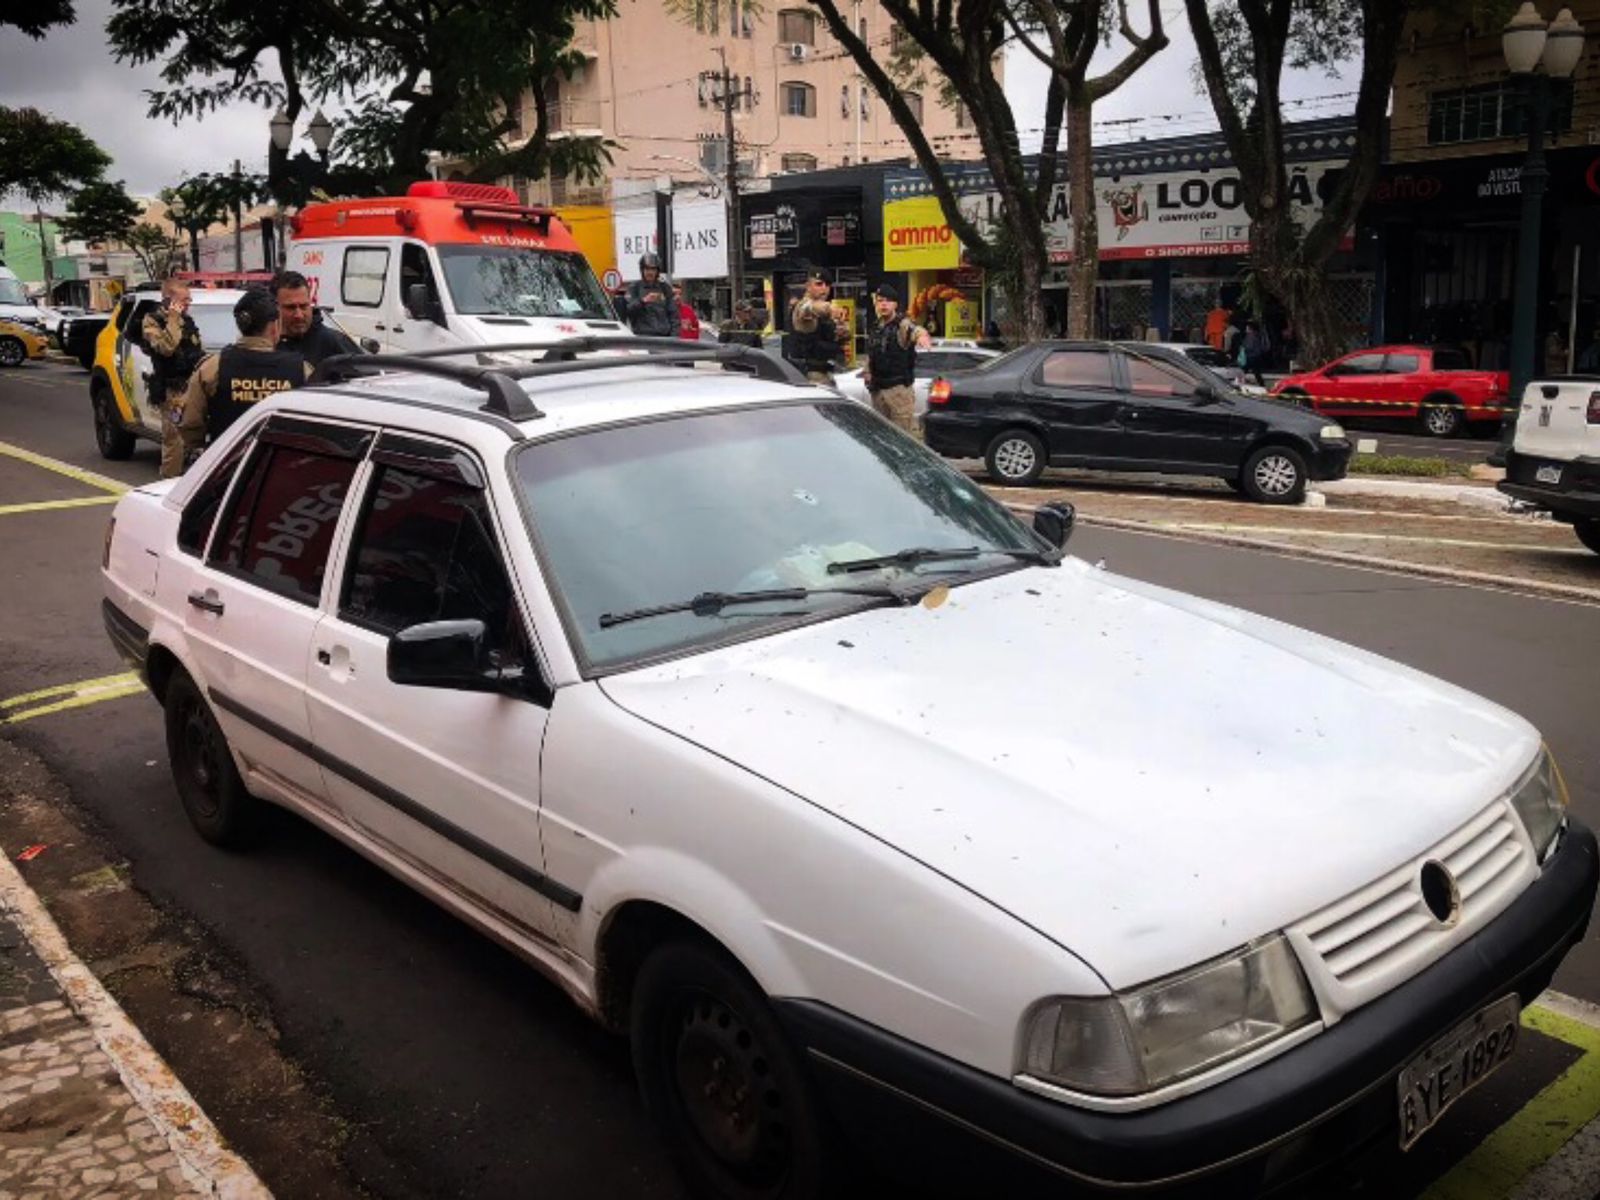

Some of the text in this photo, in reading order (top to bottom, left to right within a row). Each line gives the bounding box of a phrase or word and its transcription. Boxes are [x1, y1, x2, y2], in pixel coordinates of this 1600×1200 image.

[673, 229, 719, 251] EANS
[889, 225, 952, 245] ammo
[1158, 244, 1229, 257] SHOPPING
[306, 277, 320, 304] 92
[231, 377, 292, 391] POLÍCIA
[232, 390, 271, 402] MILIT
